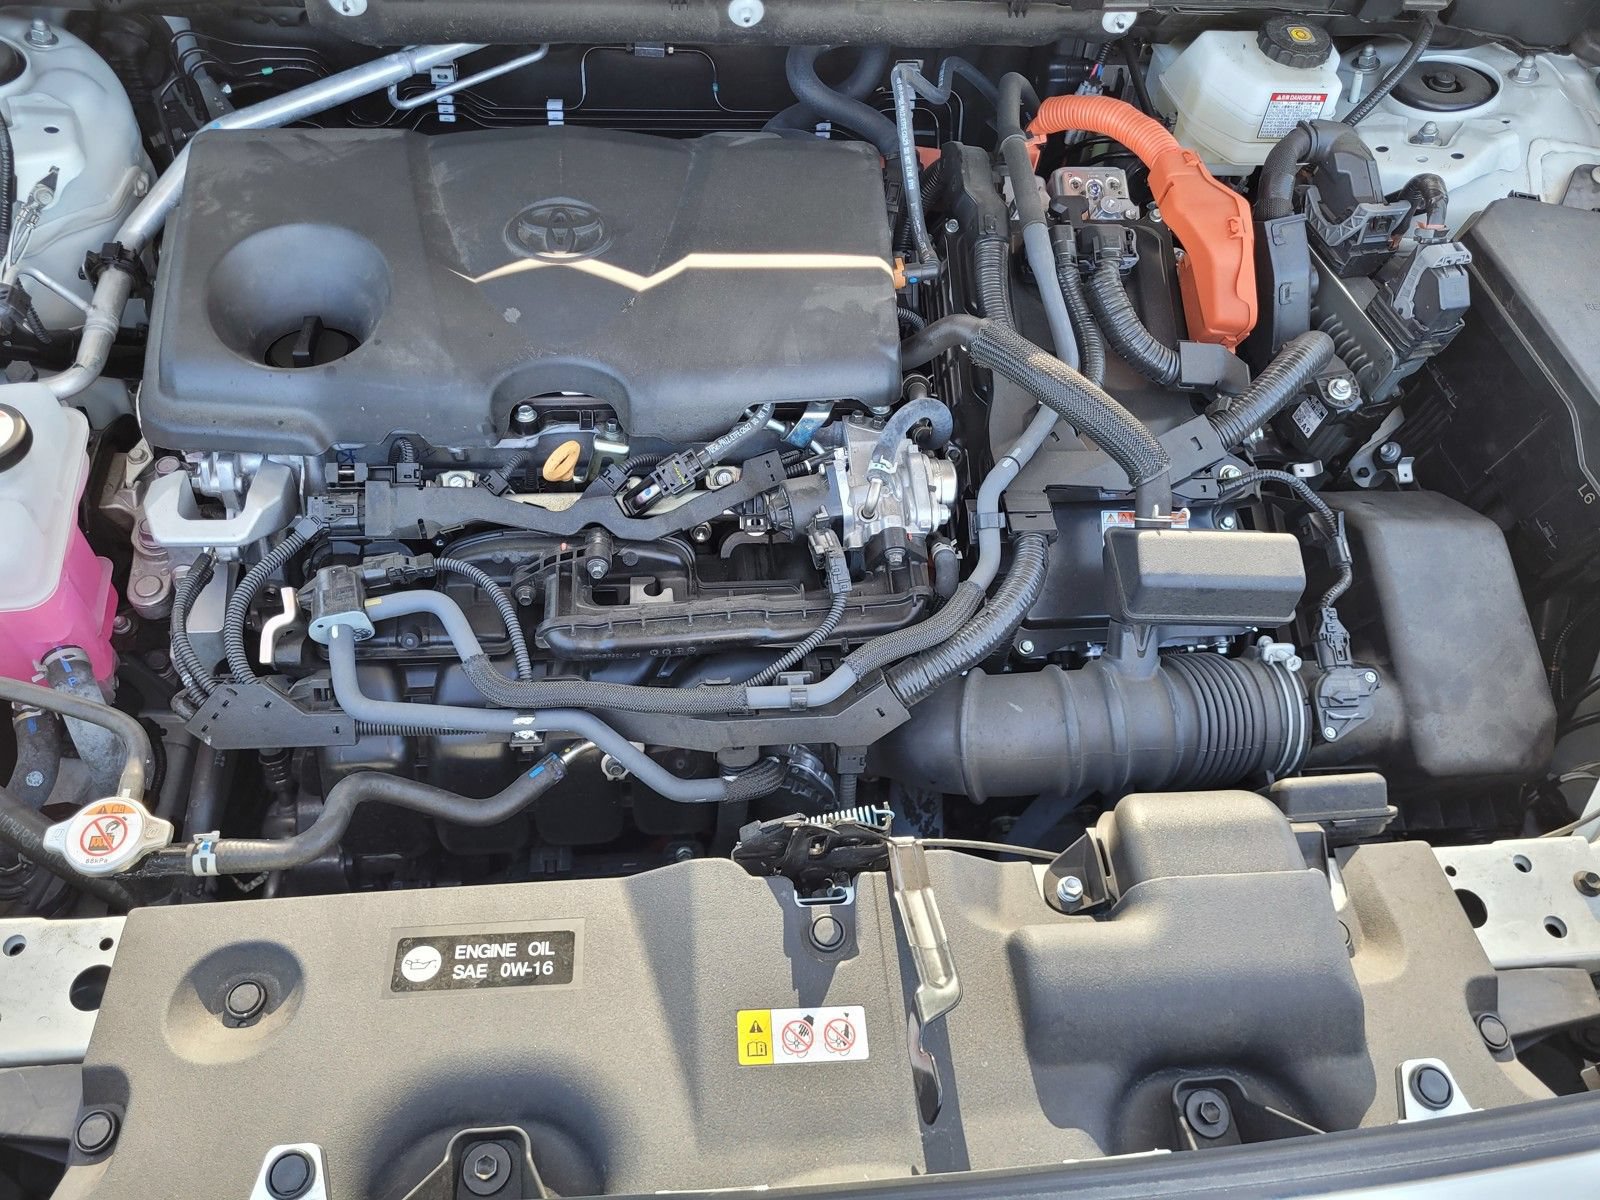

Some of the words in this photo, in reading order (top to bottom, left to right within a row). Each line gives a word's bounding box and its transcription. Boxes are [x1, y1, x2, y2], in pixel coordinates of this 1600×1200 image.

[1578, 483, 1596, 504] L6
[454, 942, 517, 960] ENGINE
[527, 941, 555, 957] OIL
[452, 963, 489, 980] SAE
[500, 961, 554, 978] 0W-16
